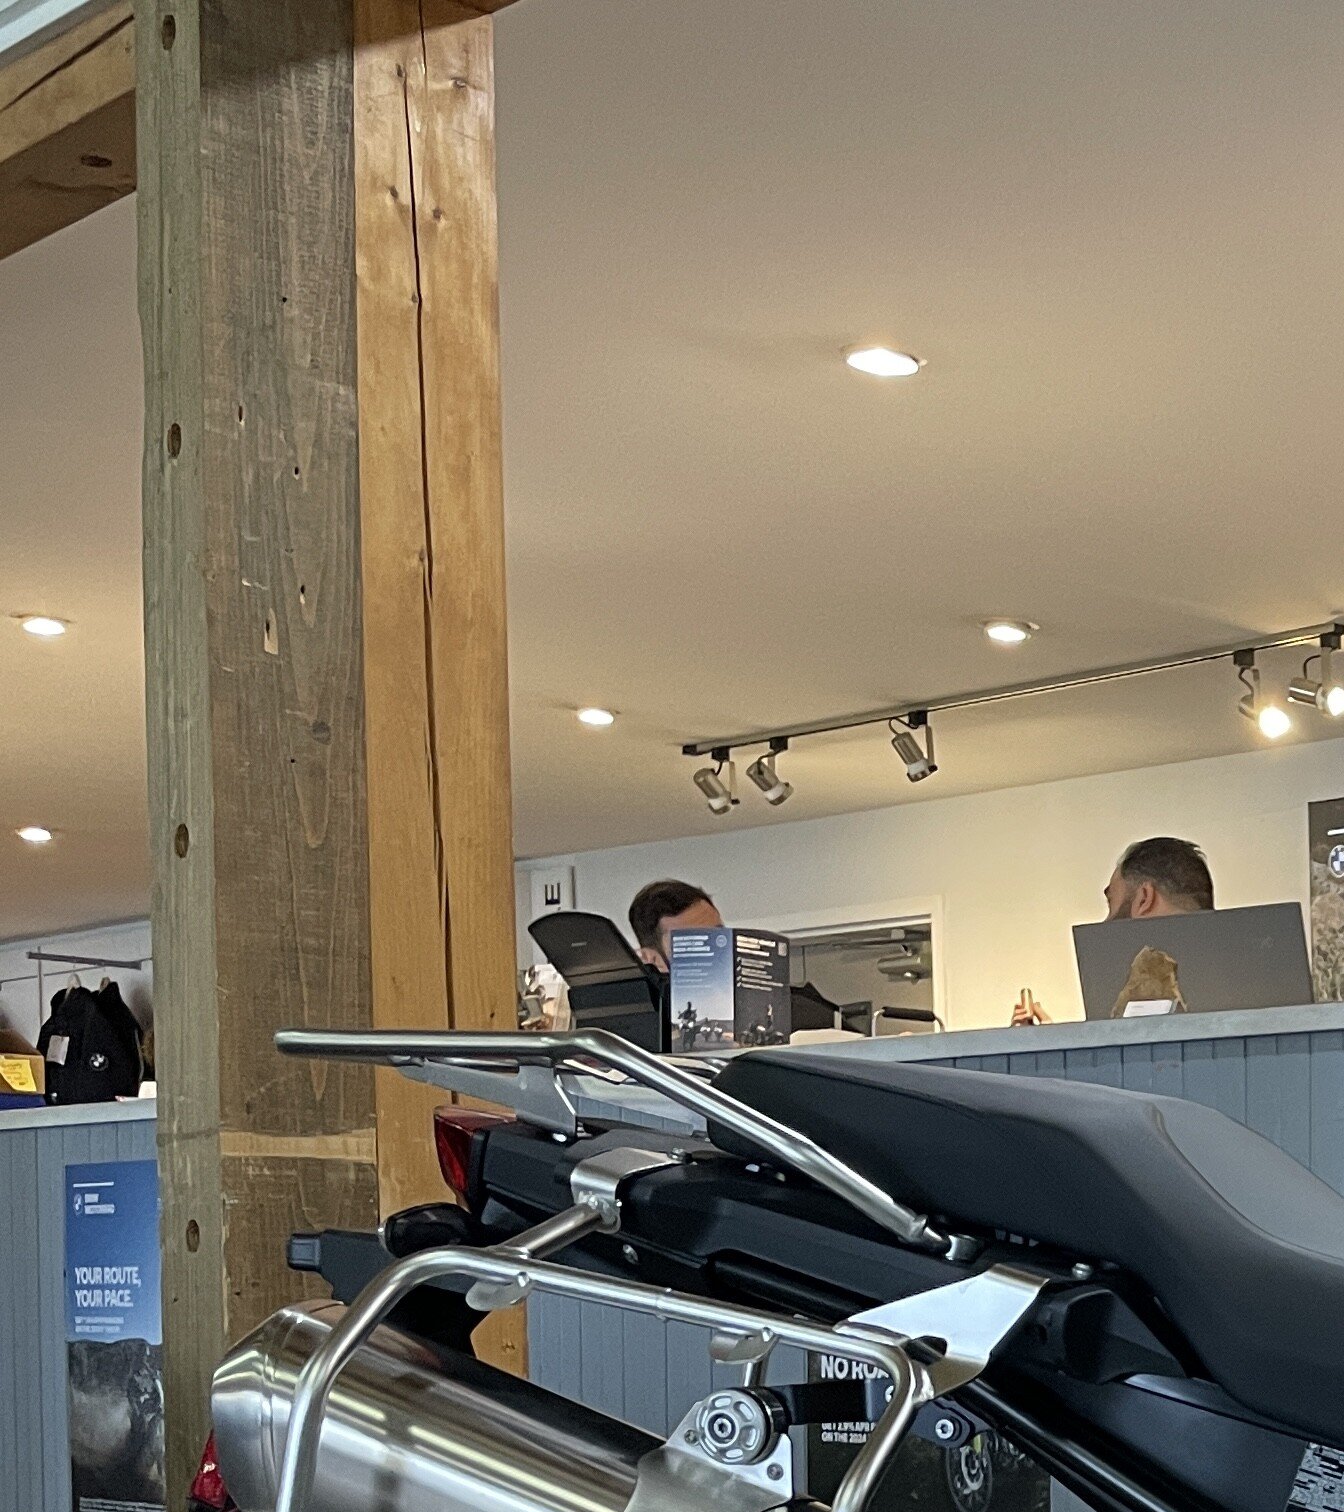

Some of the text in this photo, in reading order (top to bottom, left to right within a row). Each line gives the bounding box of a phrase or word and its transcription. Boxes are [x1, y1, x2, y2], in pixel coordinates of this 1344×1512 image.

[75, 1266, 142, 1288] YOUR ROUTE,
[75, 1289, 134, 1308] YOUR PACE.
[821, 1355, 848, 1379] NO
